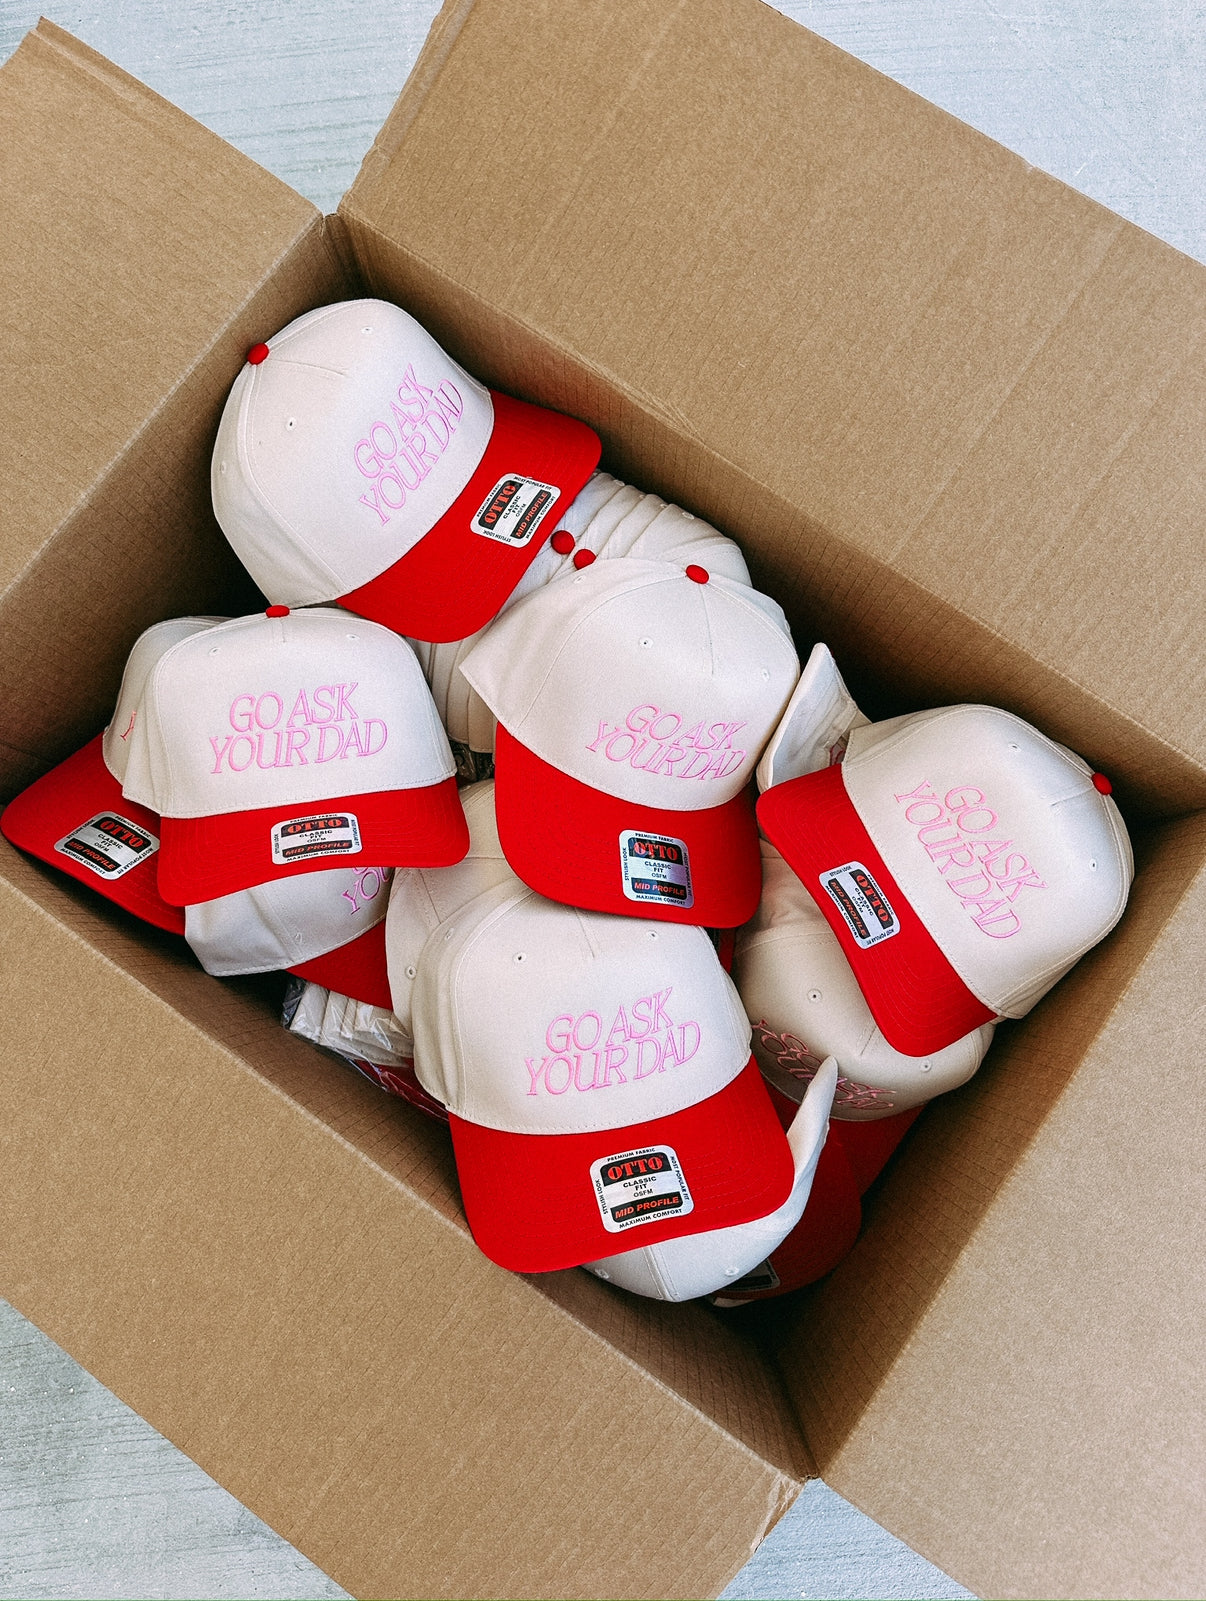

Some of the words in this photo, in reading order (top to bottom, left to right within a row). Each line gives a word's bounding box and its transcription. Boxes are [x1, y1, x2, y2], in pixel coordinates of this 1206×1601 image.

[354, 421, 397, 478] GO
[390, 363, 434, 442] ASK
[360, 432, 439, 526] YOUR
[422, 379, 464, 453] DAD
[485, 485, 515, 523] OTTO
[503, 496, 520, 519] CLASSIC
[516, 504, 526, 517] OSFM
[516, 522, 527, 537] MID
[526, 492, 548, 521] PROFILE
[230, 692, 284, 732] GO
[287, 682, 359, 728] ASK
[626, 704, 682, 740] GO
[672, 720, 748, 750] ASK
[210, 728, 311, 774] YOUR
[315, 718, 388, 764] DAD
[585, 720, 687, 776] YOUR
[677, 750, 746, 780] DAD
[944, 786, 998, 834] GO
[100, 821, 144, 847] OTTO
[288, 820, 341, 833] OTTO
[299, 830, 332, 838] CLASSIC
[94, 842, 110, 852] OSFM
[98, 833, 123, 849] CLASSIC
[285, 848, 304, 856] MID
[307, 842, 350, 851] PROFILE
[633, 842, 678, 860] OTTO
[67, 841, 84, 851] MID
[83, 848, 116, 870] PROFILE
[645, 861, 671, 870] CLASSIC
[894, 780, 976, 874] YOUR
[946, 869, 1022, 938] DAD
[969, 840, 1048, 903] ASK
[634, 882, 650, 890] MID
[653, 885, 684, 896] PROFILE
[855, 888, 873, 916] CLASSIC
[857, 875, 889, 921] OTTO
[831, 882, 845, 897] MID
[843, 899, 867, 936] PROFILE
[546, 1010, 602, 1054] GO
[606, 986, 674, 1047] ASK
[524, 1044, 628, 1096] YOUR
[634, 1020, 701, 1080] DAD
[607, 1152, 634, 1162] PREMIUM
[608, 1156, 662, 1180] OTTO
[623, 1176, 657, 1187] CLASSIC
[670, 1156, 679, 1171] MOST
[676, 1170, 686, 1193] POPULAR
[633, 1189, 653, 1197] OSFM
[615, 1207, 634, 1219] MID
[636, 1196, 679, 1211] PROFILE
[619, 1215, 651, 1228] MAXIMUM
[653, 1209, 682, 1218] COMFORT
